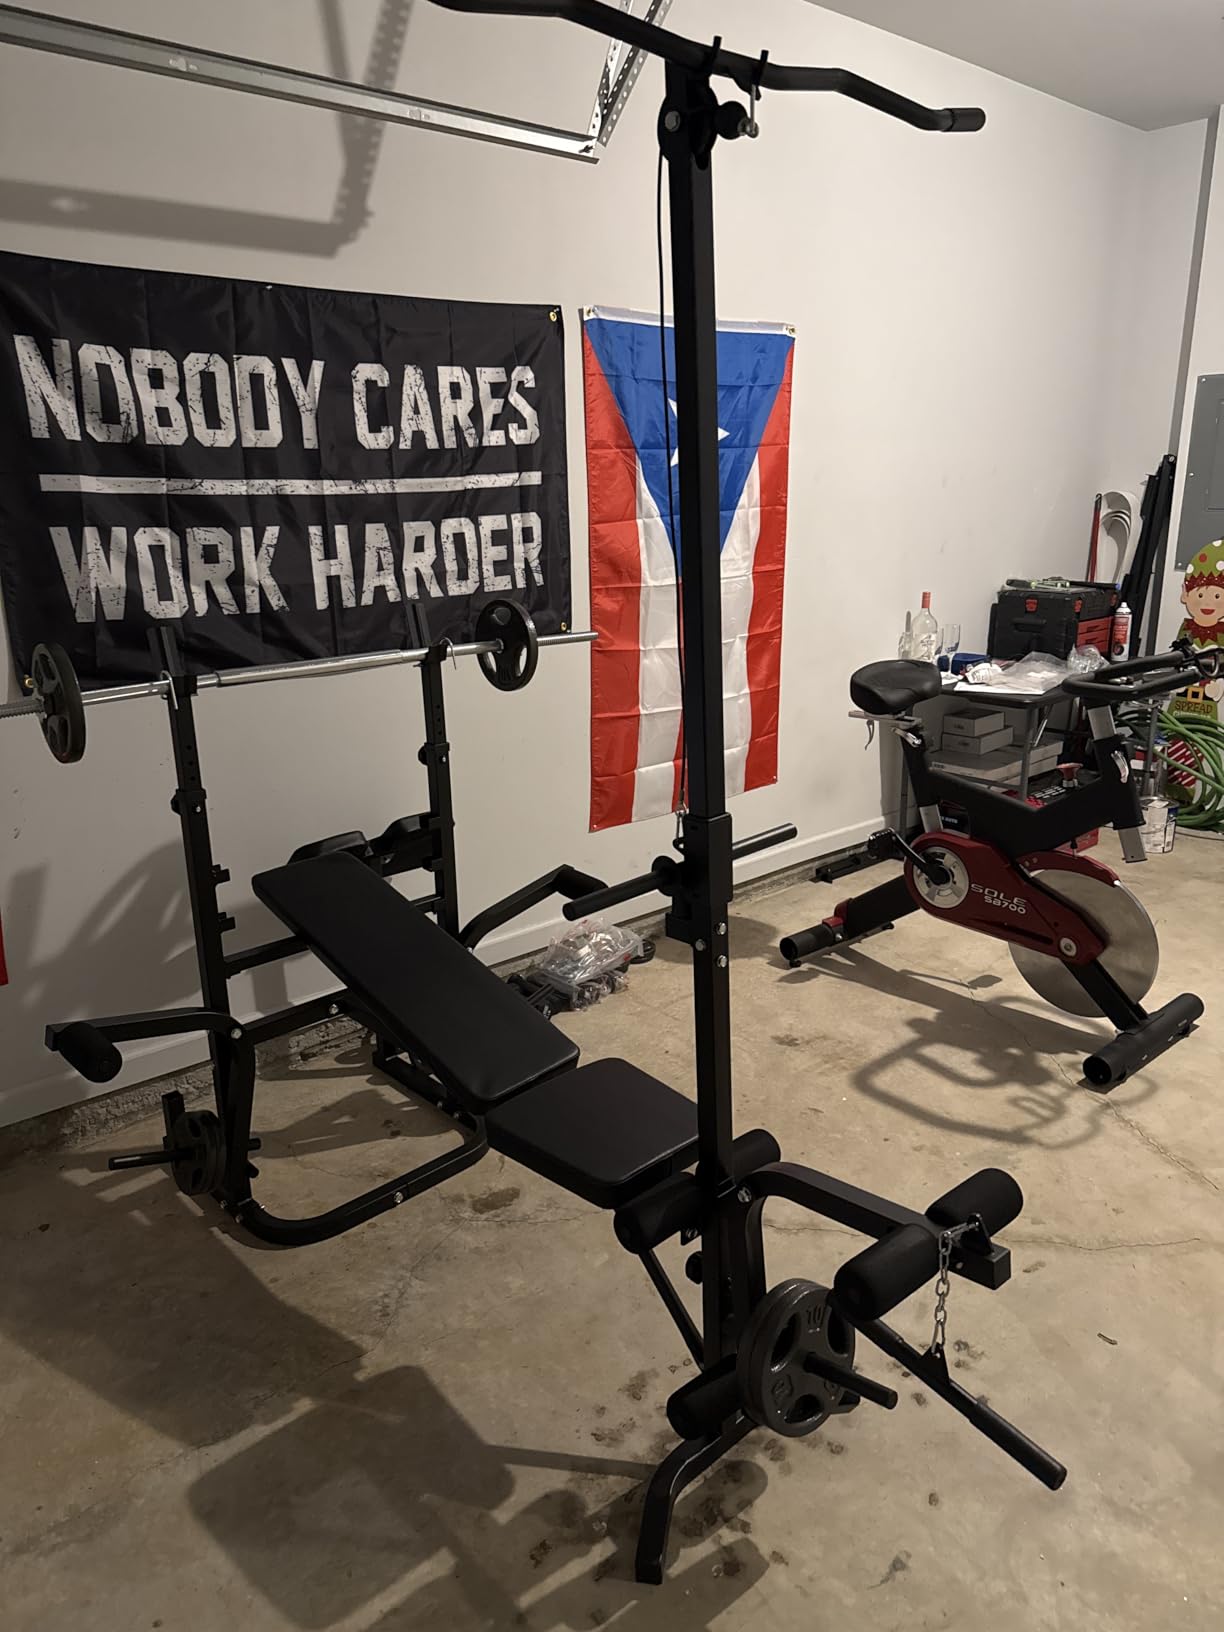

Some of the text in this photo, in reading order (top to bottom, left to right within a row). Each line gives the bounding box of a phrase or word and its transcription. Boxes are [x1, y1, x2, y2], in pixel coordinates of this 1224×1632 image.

[13, 334, 541, 450] NOBODY CARES
[49, 511, 545, 623] WORK HARDER
[1175, 700, 1213, 714] SPREAD
[971, 883, 1027, 907] SOLE
[984, 895, 1026, 914] SB700
